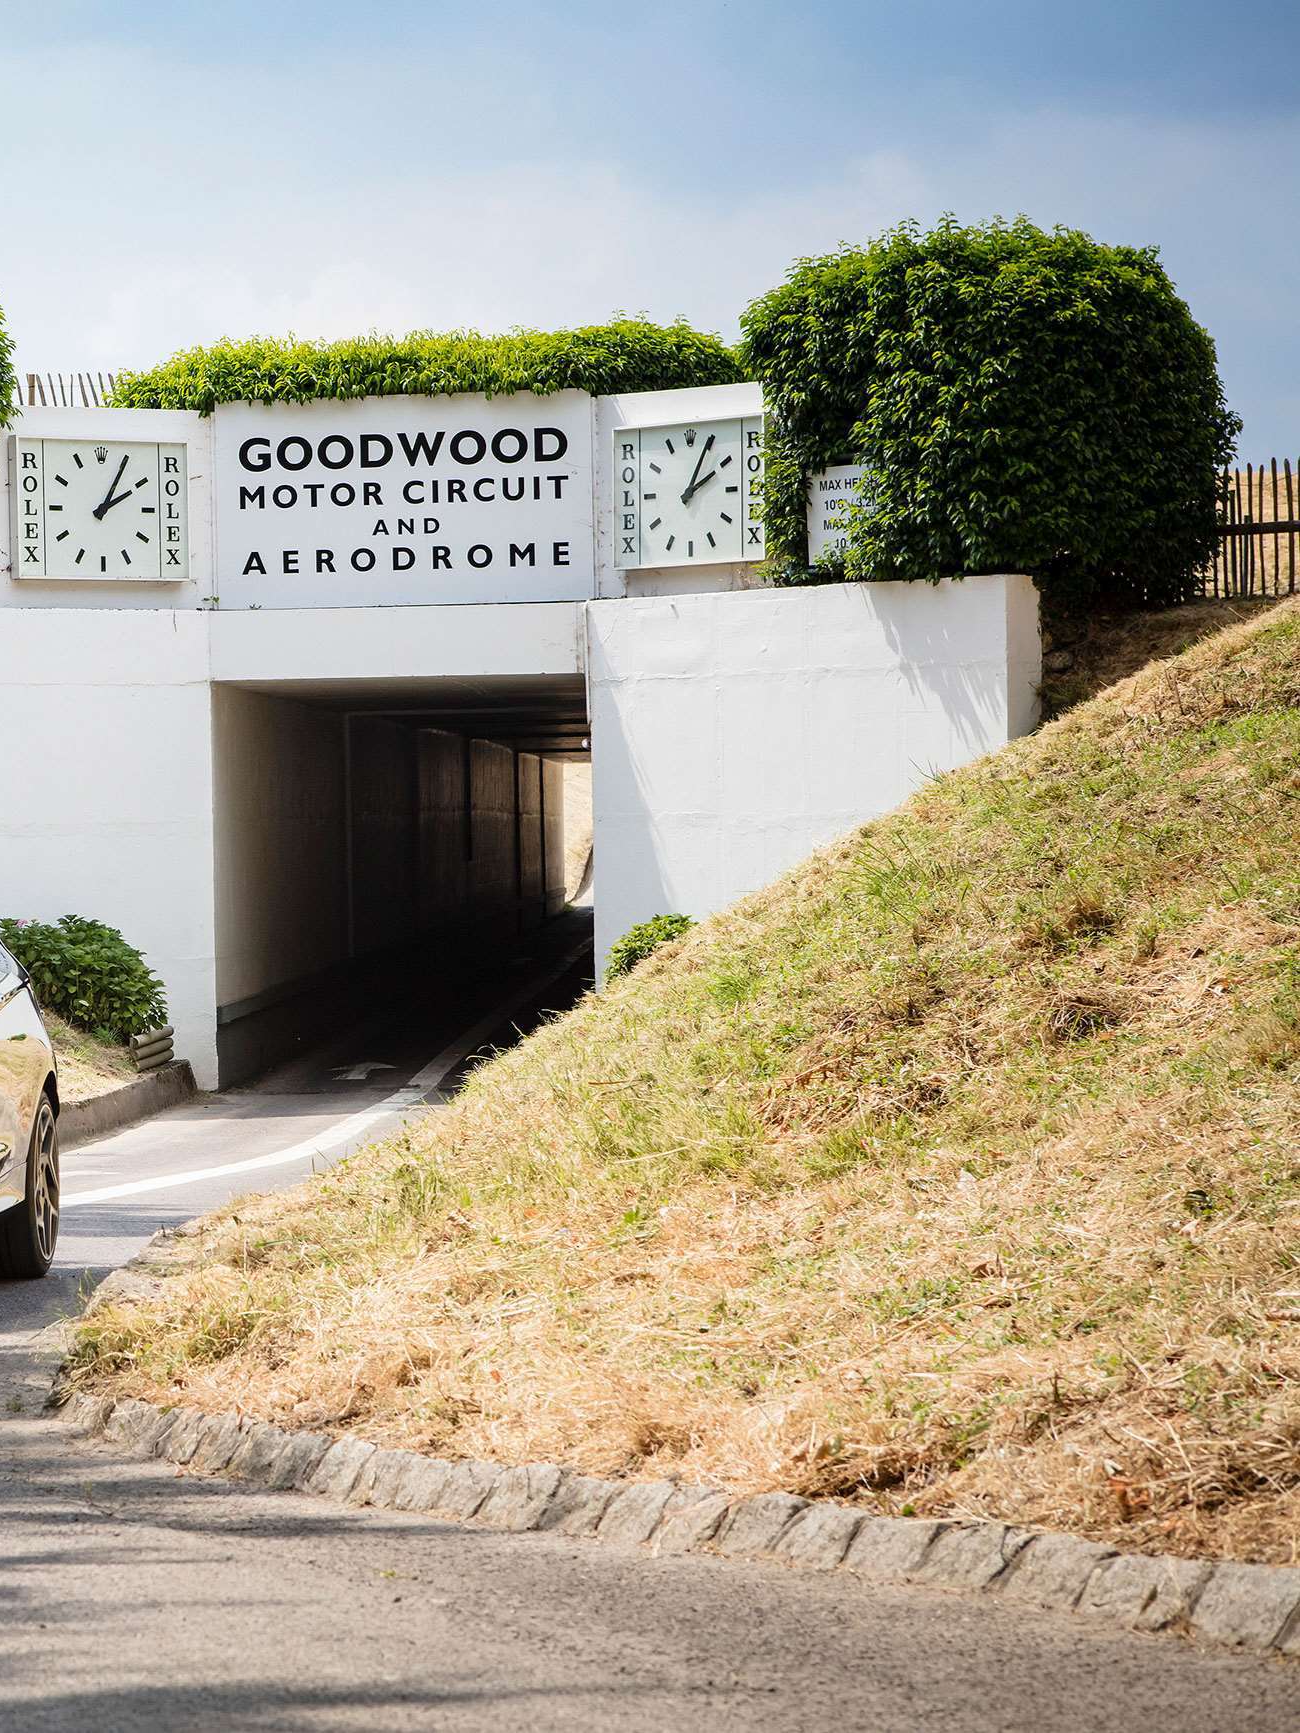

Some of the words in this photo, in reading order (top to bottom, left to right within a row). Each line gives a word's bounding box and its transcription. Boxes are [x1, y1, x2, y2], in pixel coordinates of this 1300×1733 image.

[238, 427, 568, 472] GOODWOOD
[239, 482, 384, 510] MOTOR
[402, 475, 569, 505] CIRCUIT
[621, 443, 636, 554] ROLEX
[819, 479, 841, 491] MAX
[21, 452, 40, 563] ROLEX
[163, 456, 181, 566] ROLEX
[372, 518, 440, 536] AND
[242, 541, 570, 576] AERODROME
